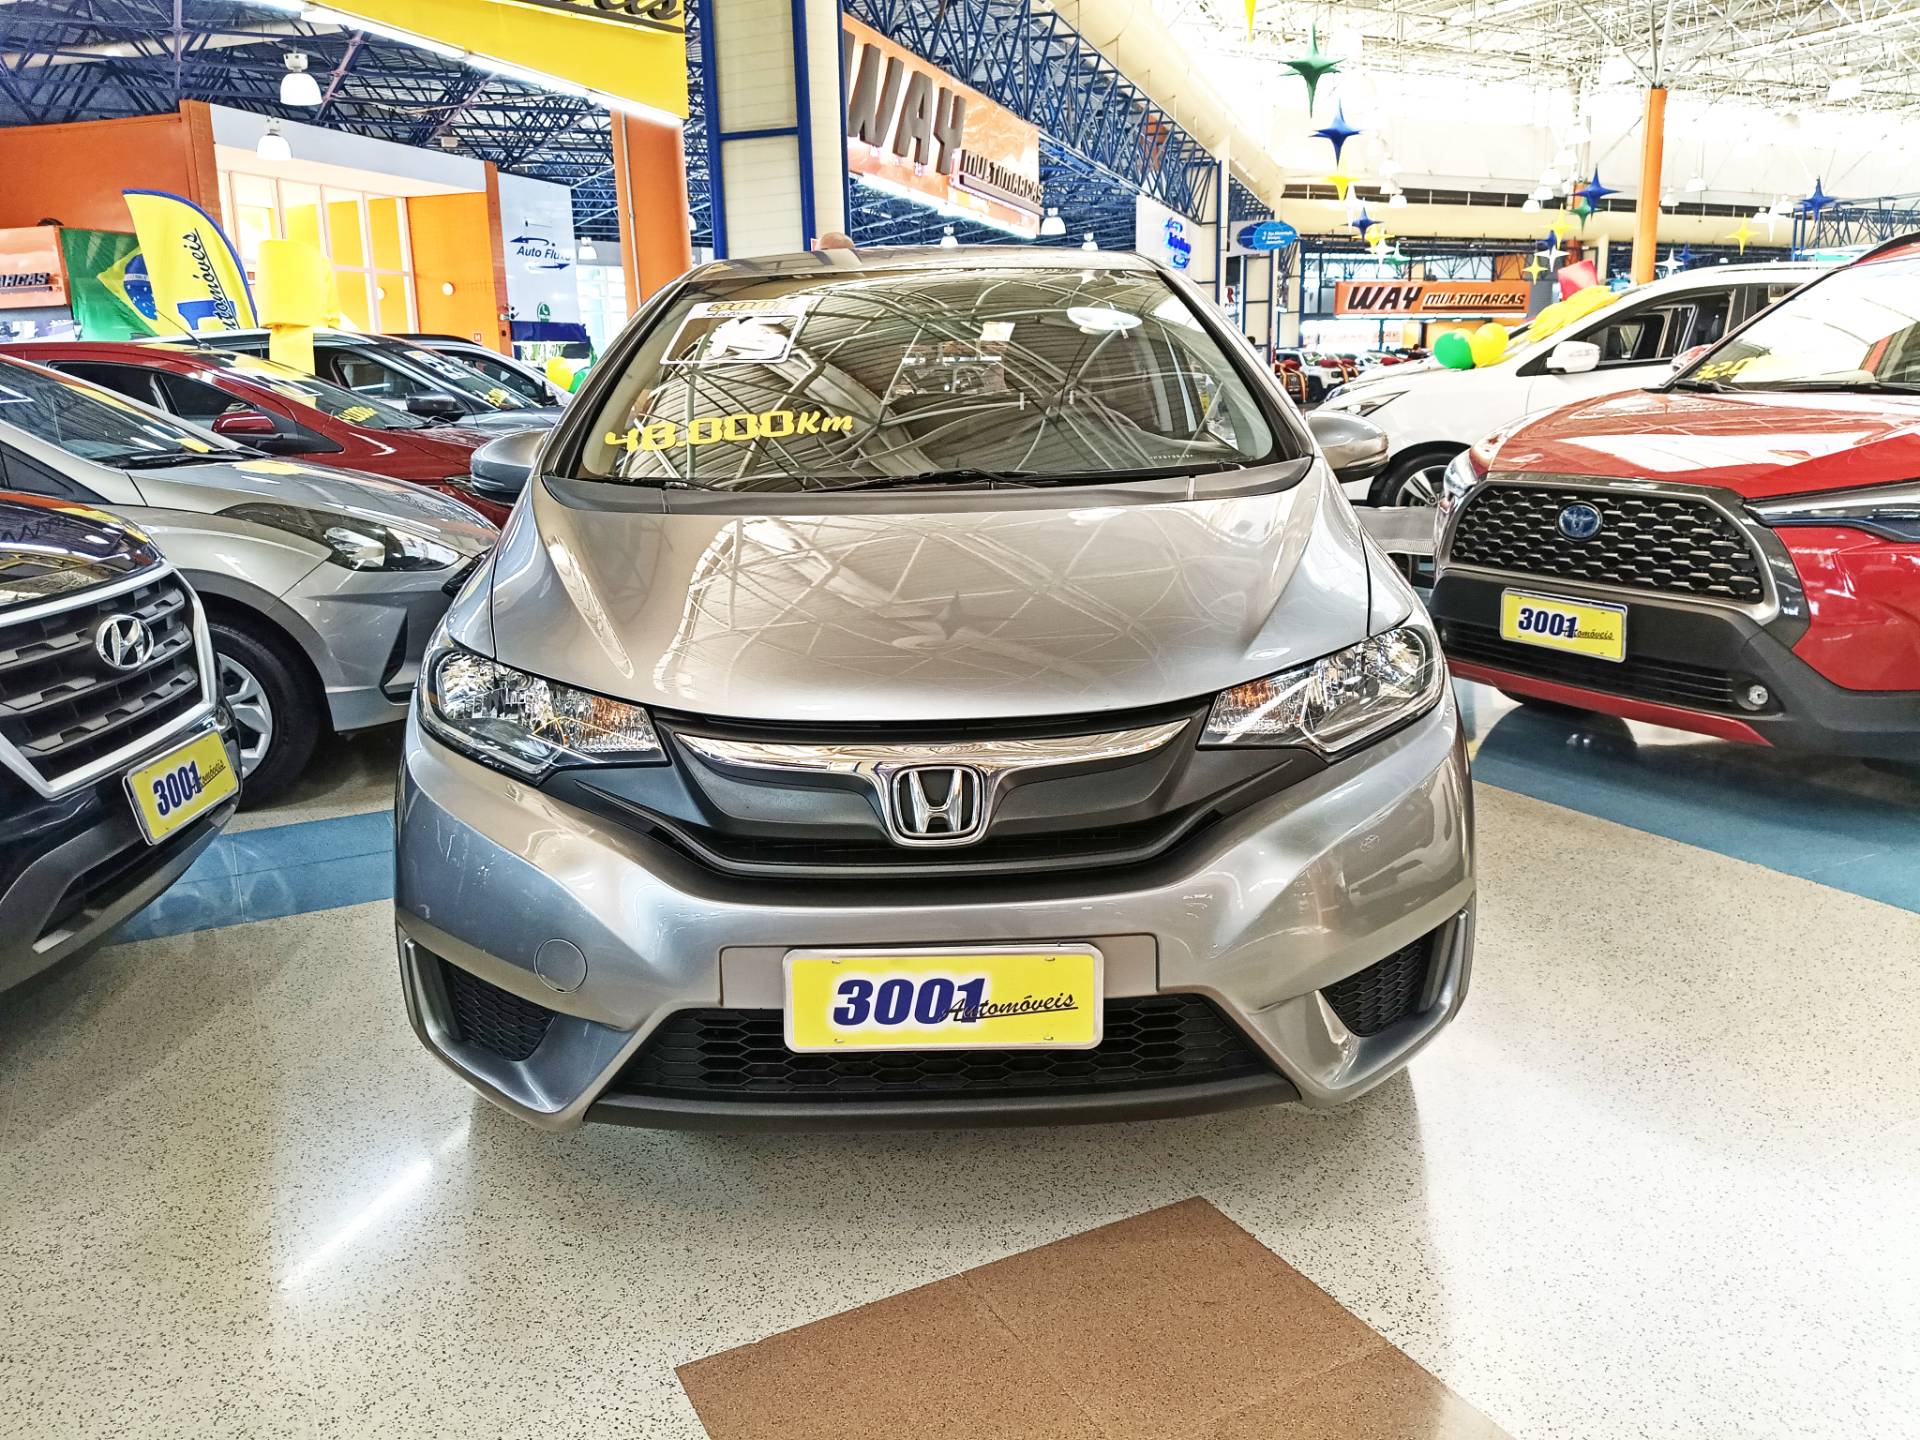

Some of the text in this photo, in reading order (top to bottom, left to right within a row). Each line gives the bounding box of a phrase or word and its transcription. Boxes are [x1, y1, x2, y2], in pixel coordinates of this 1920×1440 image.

[842, 29, 967, 176] WAY
[516, 245, 571, 261] Auto Flu
[1348, 286, 1526, 311] WAY MULTIMARCAS
[1518, 607, 1577, 639] 3001
[152, 760, 202, 816] 3001
[832, 977, 1078, 1026] 3001 Automóveis
